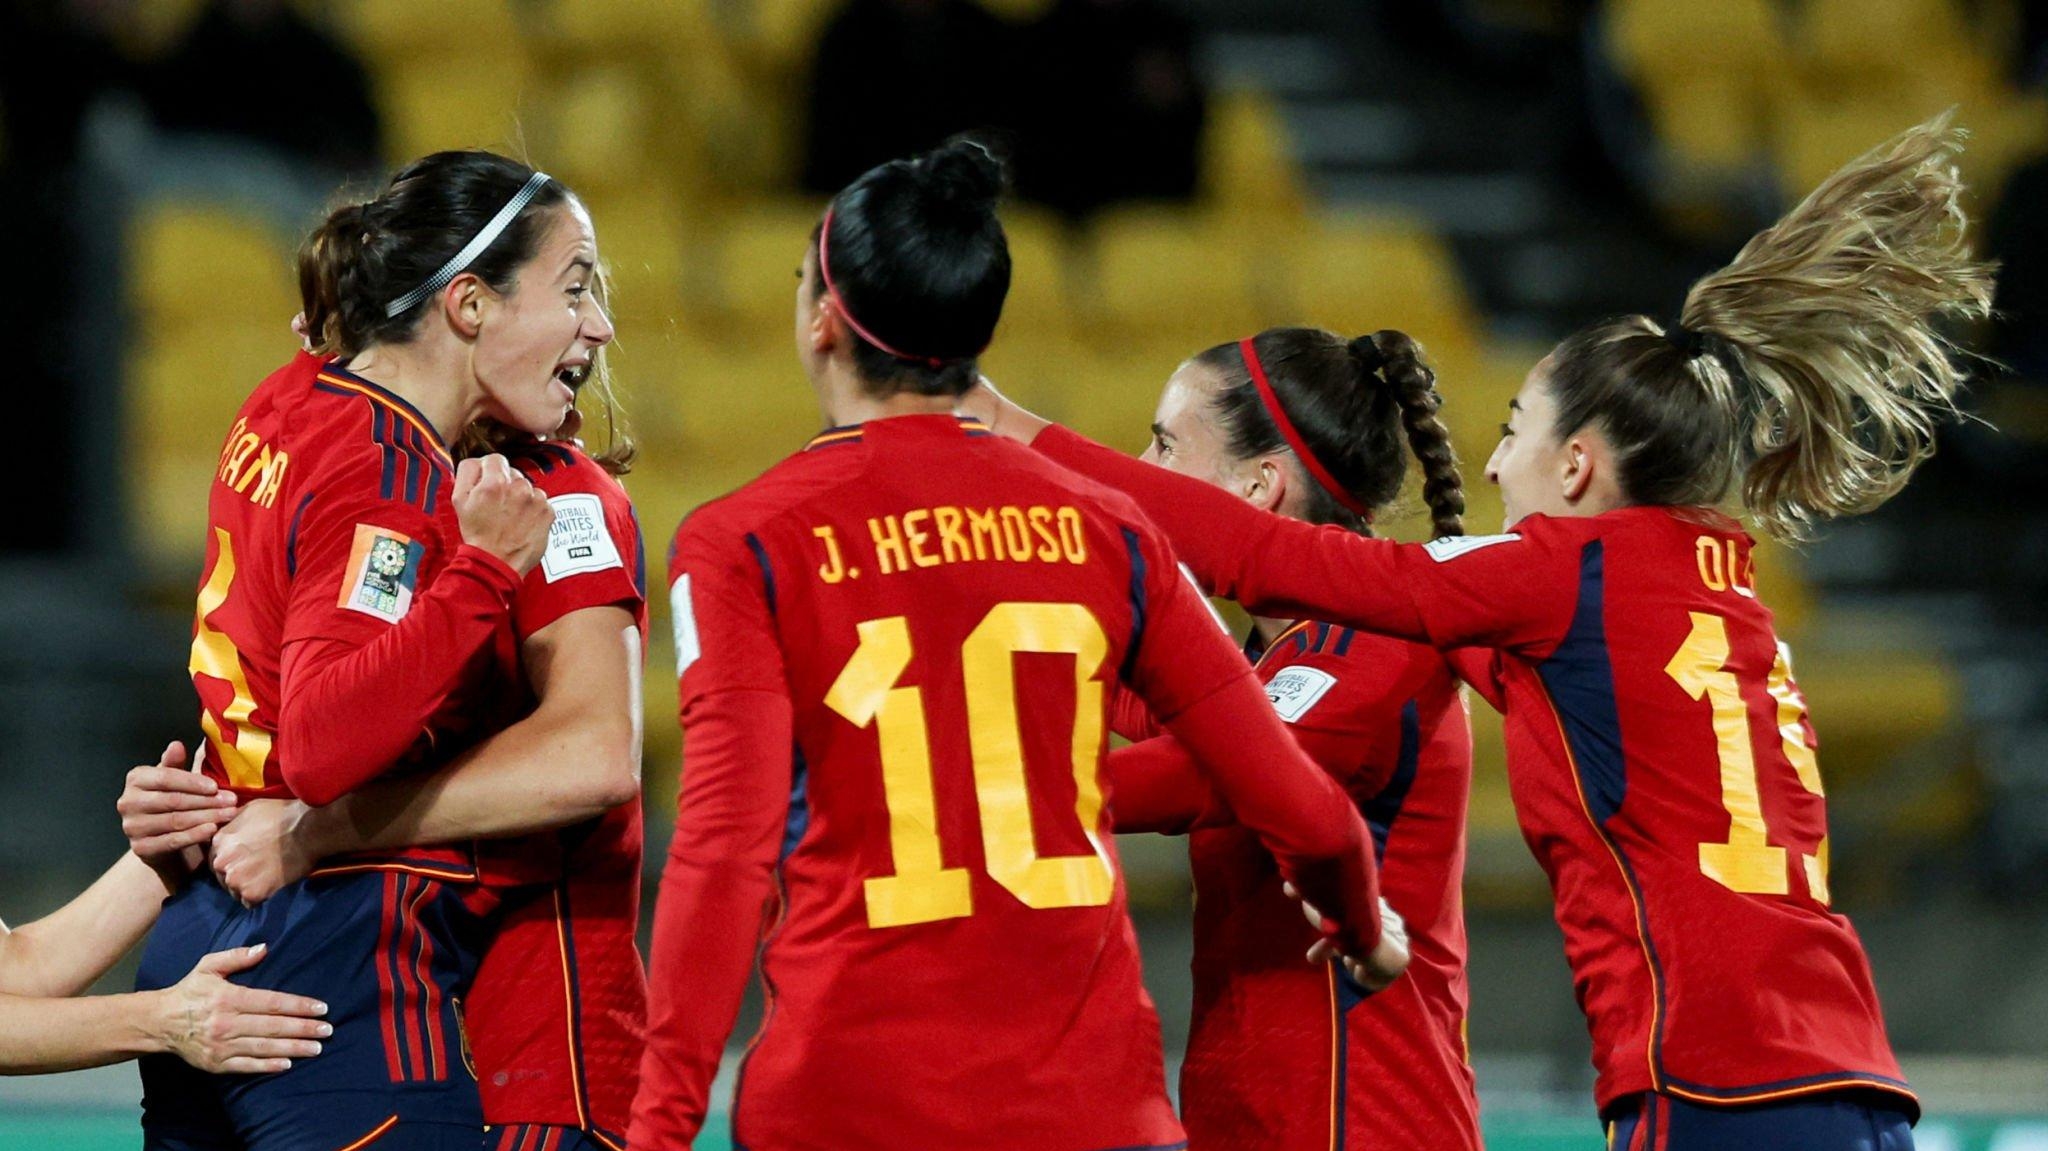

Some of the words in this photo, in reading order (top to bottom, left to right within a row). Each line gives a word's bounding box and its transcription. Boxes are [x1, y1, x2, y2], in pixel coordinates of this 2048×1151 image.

[556, 507, 589, 518] OTBALL
[813, 525, 859, 583] J.
[867, 506, 1087, 575] HERMOSO
[1266, 680, 1306, 692] NITES
[823, 602, 1115, 929] 10
